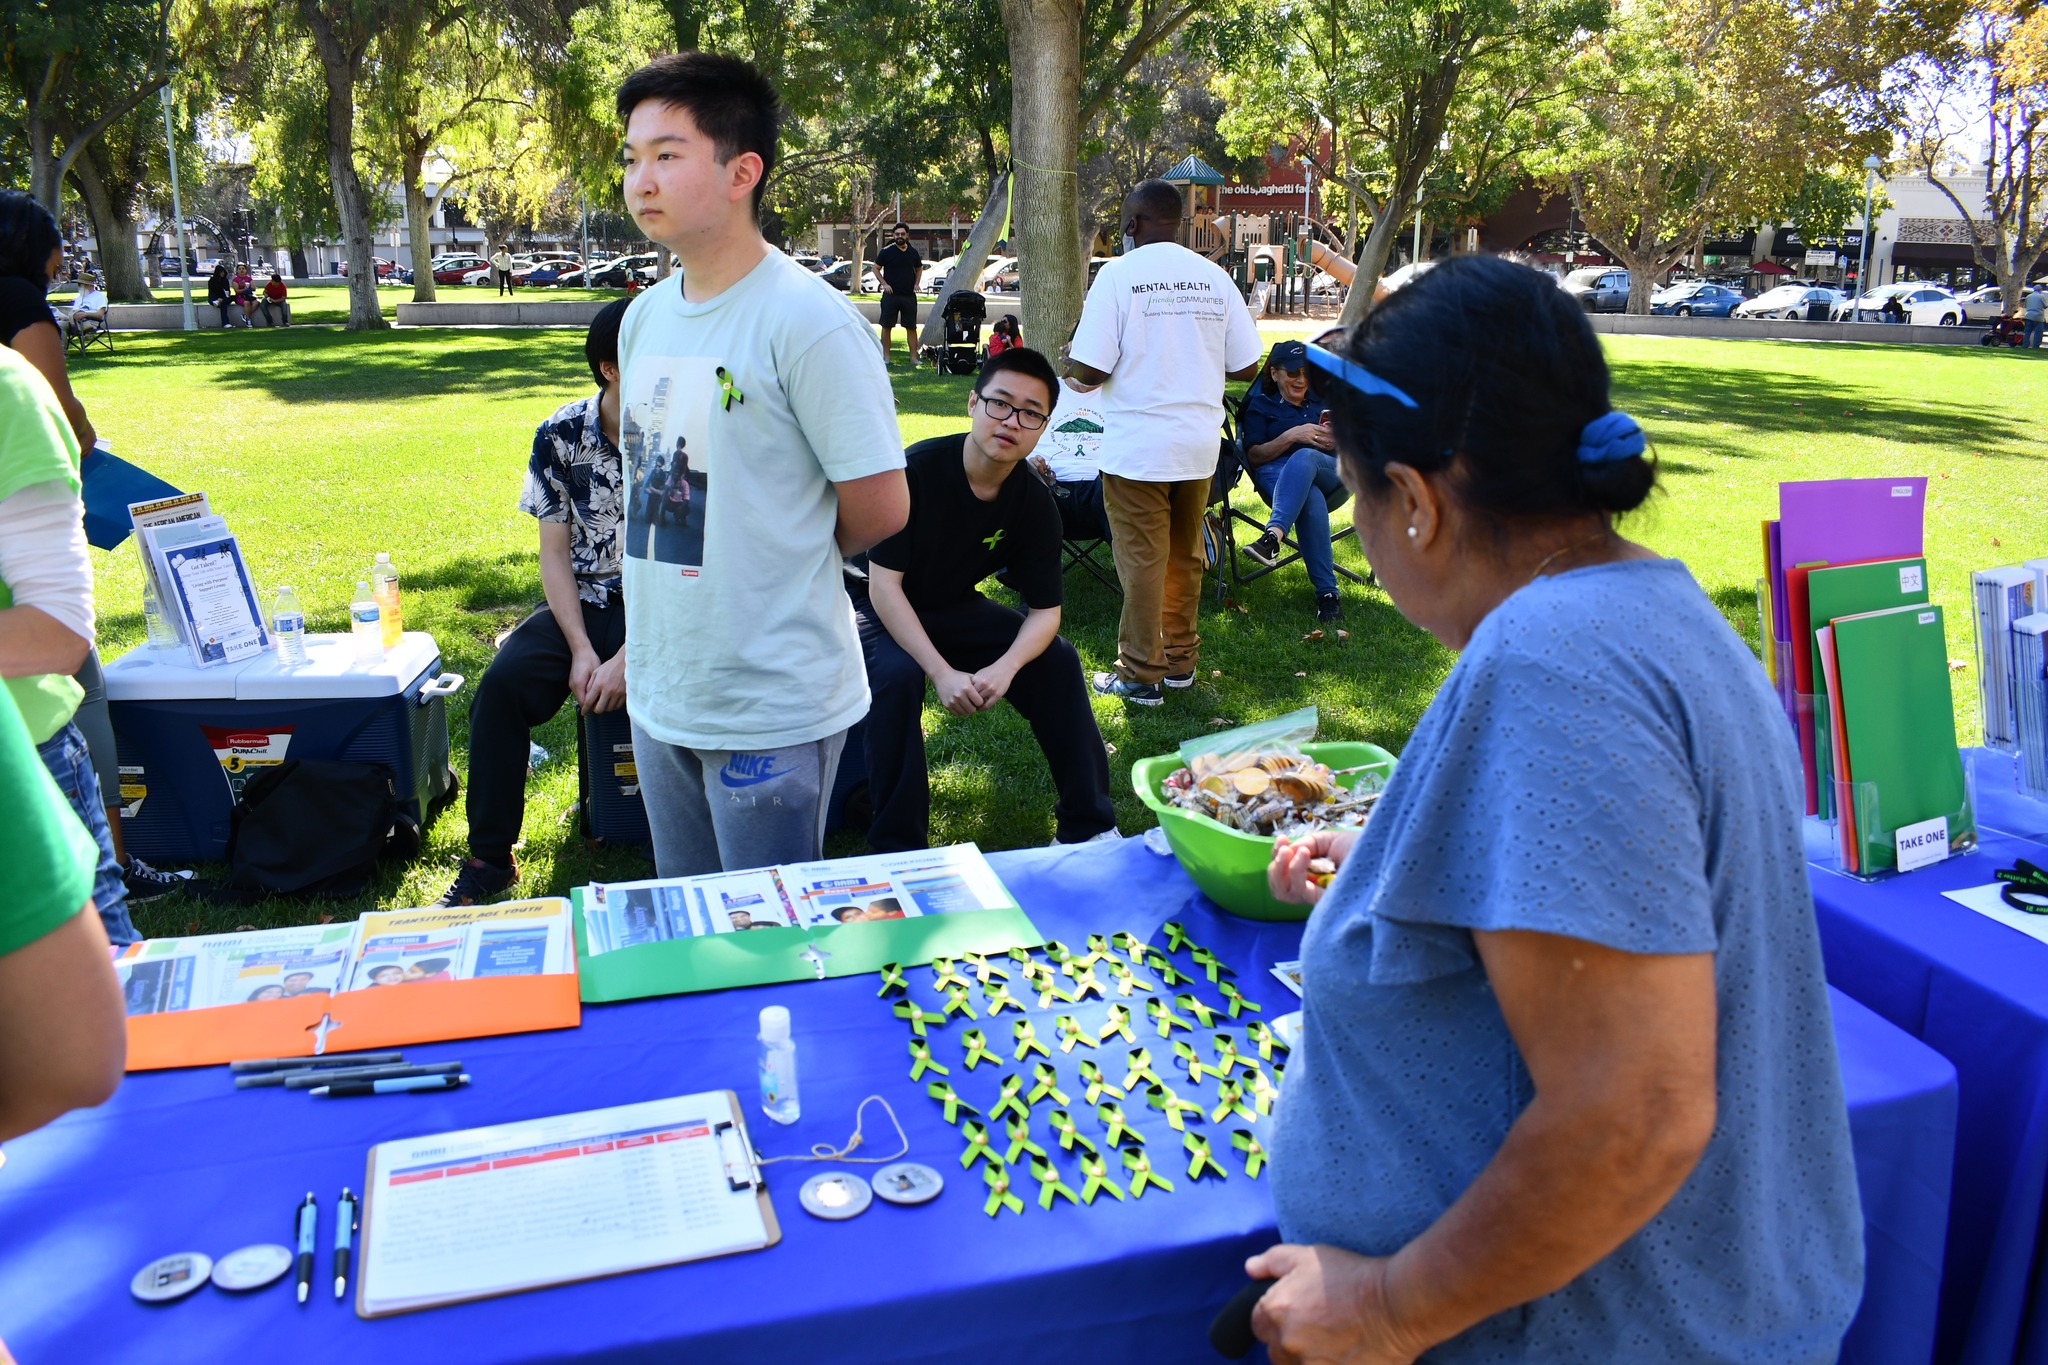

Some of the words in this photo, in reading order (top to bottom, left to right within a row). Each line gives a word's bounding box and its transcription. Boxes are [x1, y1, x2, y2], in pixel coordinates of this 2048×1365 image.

[1234, 184, 1249, 194] old
[1250, 184, 1294, 196] spaghetti
[1132, 282, 1172, 294] MENTAL
[1173, 282, 1210, 291] HEALTH
[1142, 291, 1175, 314] friendly
[1176, 296, 1224, 305] COMMUNITIES
[200, 560, 217, 568] Talent?
[1901, 573, 1919, 587] 中文
[226, 642, 243, 652] TAKE
[244, 639, 258, 648] ONE
[230, 758, 240, 770] 5
[728, 752, 776, 777] NIKE
[1900, 836, 1923, 850] TAKE
[1926, 830, 1945, 843] ONE
[2004, 874, 2027, 884] Matter
[388, 913, 472, 926] TRANSITIONAL
[476, 910, 499, 918] AGE
[504, 906, 543, 914] YOUTH
